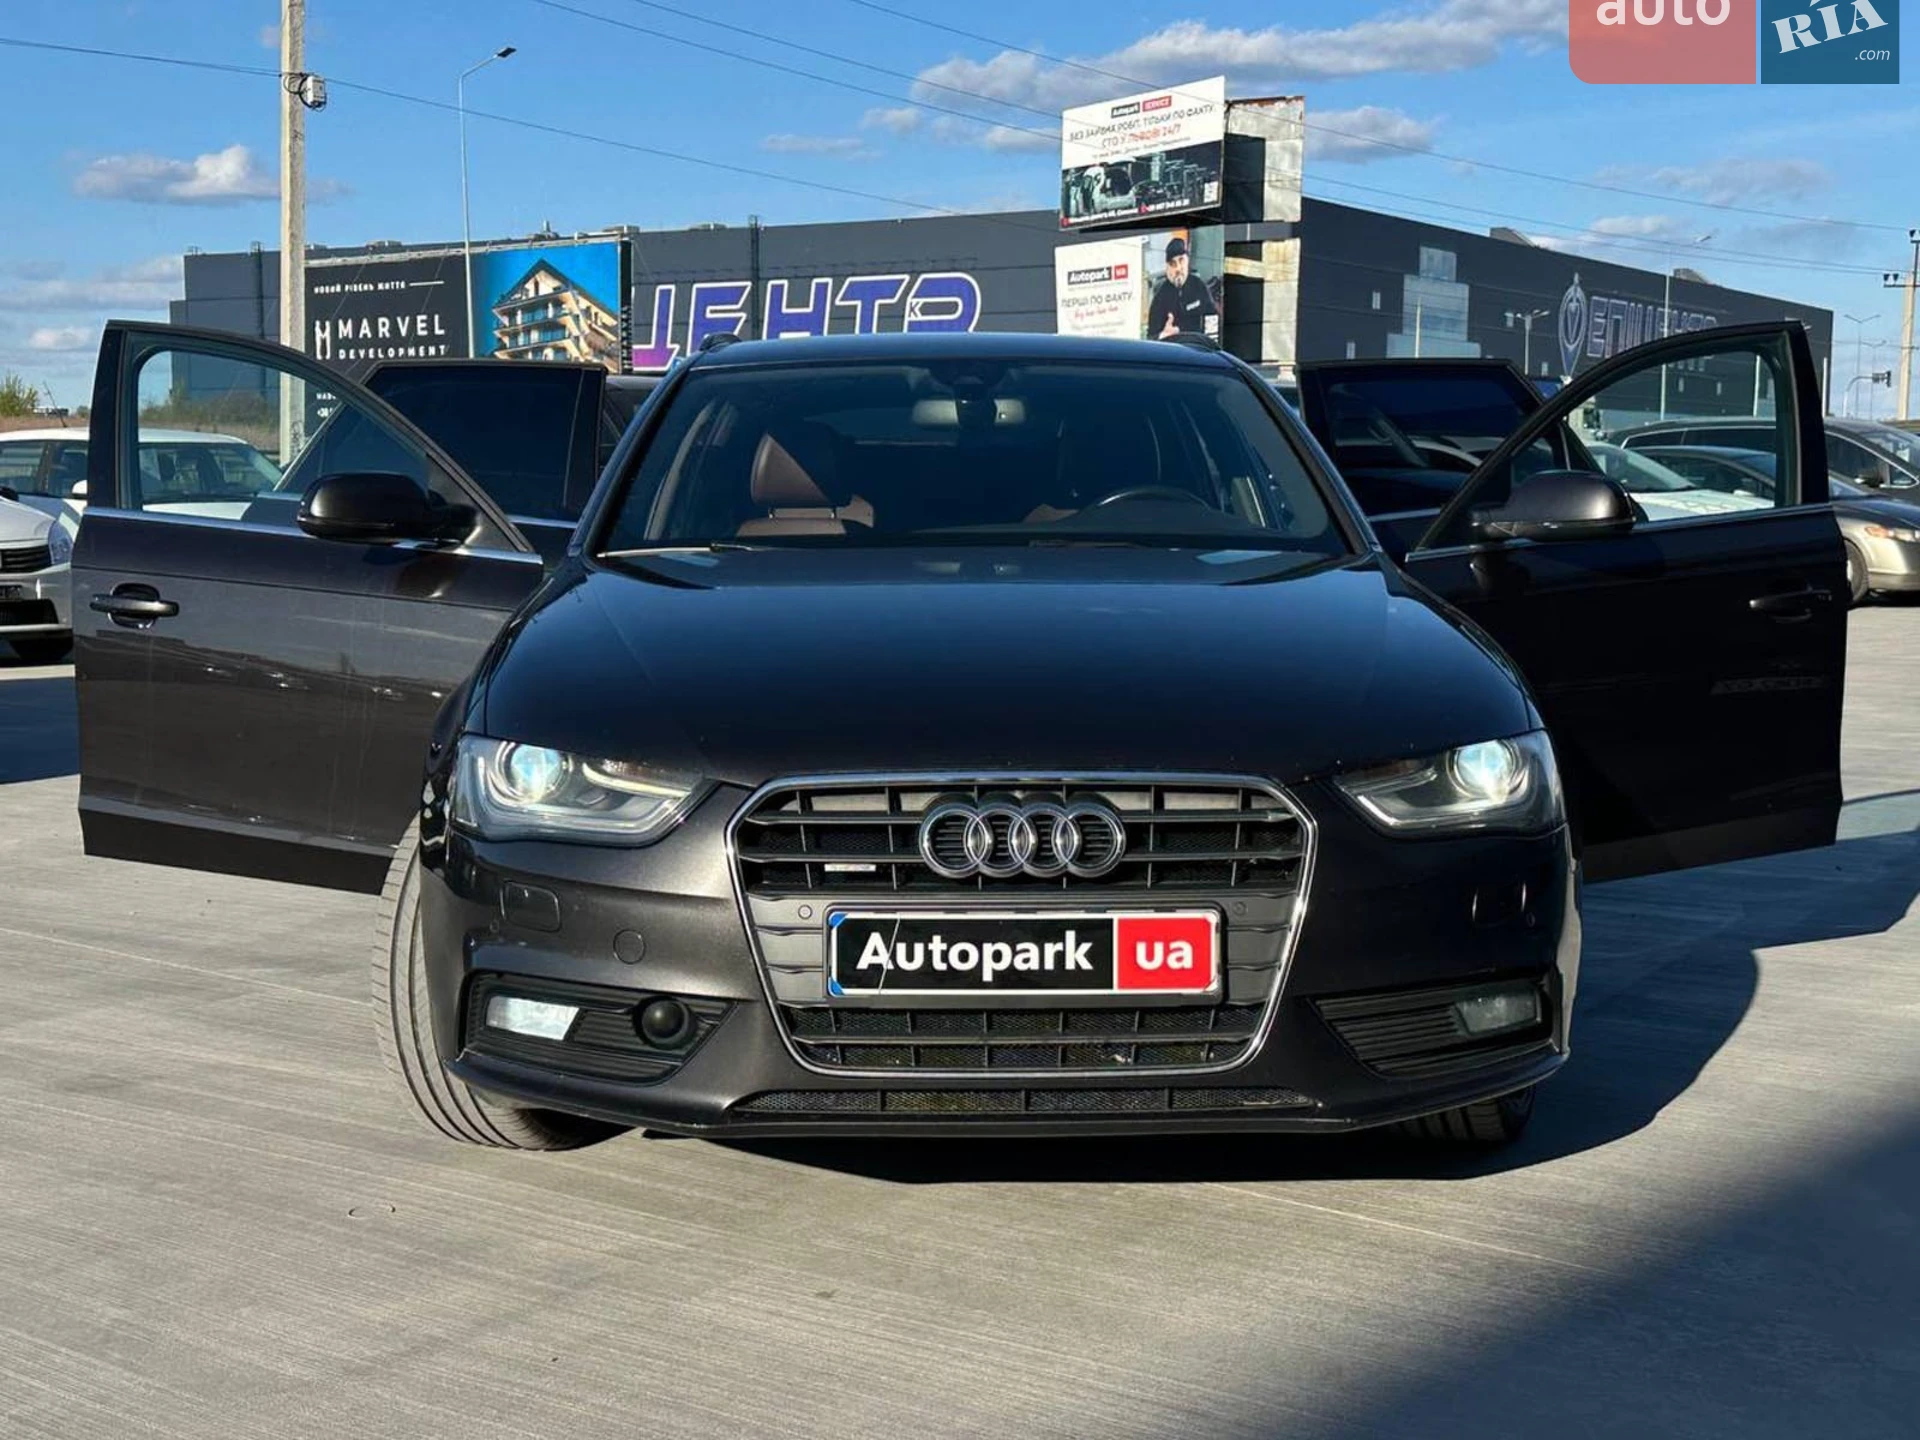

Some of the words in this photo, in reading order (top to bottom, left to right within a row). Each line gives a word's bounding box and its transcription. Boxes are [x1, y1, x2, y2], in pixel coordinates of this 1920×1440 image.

[1069, 267, 1110, 283] Autopark
[314, 284, 341, 293] НОВИЙ
[345, 283, 374, 292] РІВЕНЬ
[377, 281, 406, 290] ЖИТТЯ
[1091, 294, 1103, 305] ПО
[338, 314, 446, 340] MARVEL
[338, 344, 446, 360] DEVELOPMENT
[855, 930, 1094, 982] Autopark
[1135, 939, 1194, 970] ua
